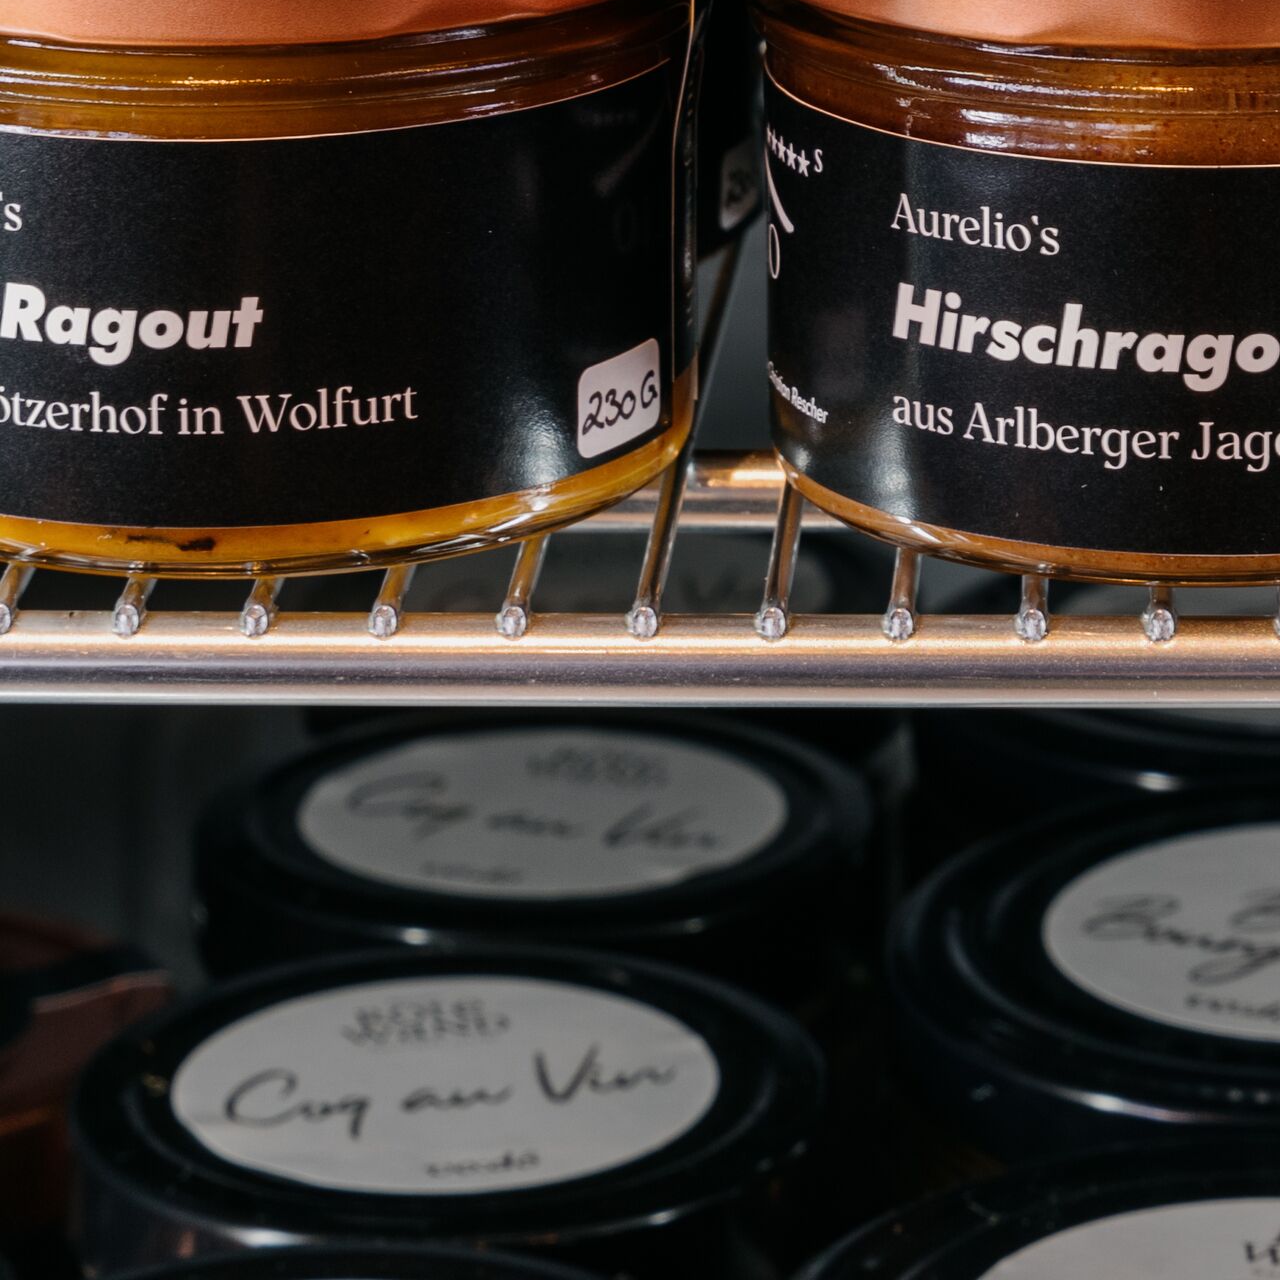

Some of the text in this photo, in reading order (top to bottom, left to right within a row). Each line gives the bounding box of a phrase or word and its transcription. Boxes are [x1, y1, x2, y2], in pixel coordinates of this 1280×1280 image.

[178, 399, 224, 434] in
[237, 386, 418, 433] Wolfurt
[891, 395, 953, 436] aus
[963, 402, 1179, 469] Arlberger
